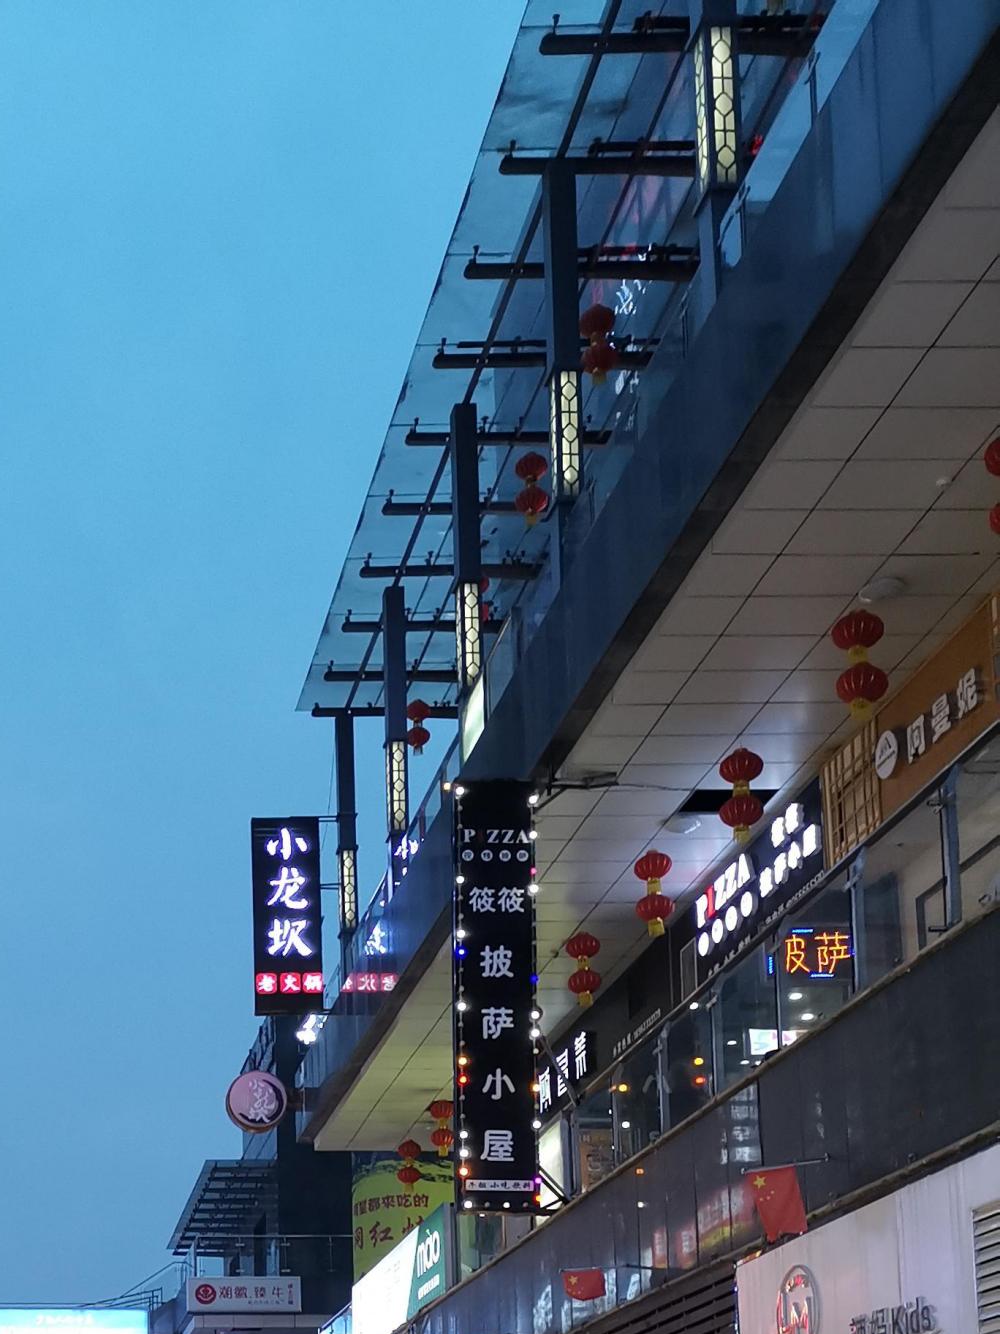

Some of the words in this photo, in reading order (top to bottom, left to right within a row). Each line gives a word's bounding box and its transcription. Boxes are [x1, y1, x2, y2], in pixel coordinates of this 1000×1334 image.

[906, 667, 978, 764] 阿曼妮
[463, 828, 531, 843] PZZA
[266, 827, 312, 957] 小龙坎
[695, 852, 752, 929] PIZZA
[784, 931, 850, 974] 皮萨
[479, 944, 515, 1163] 披萨小屋
